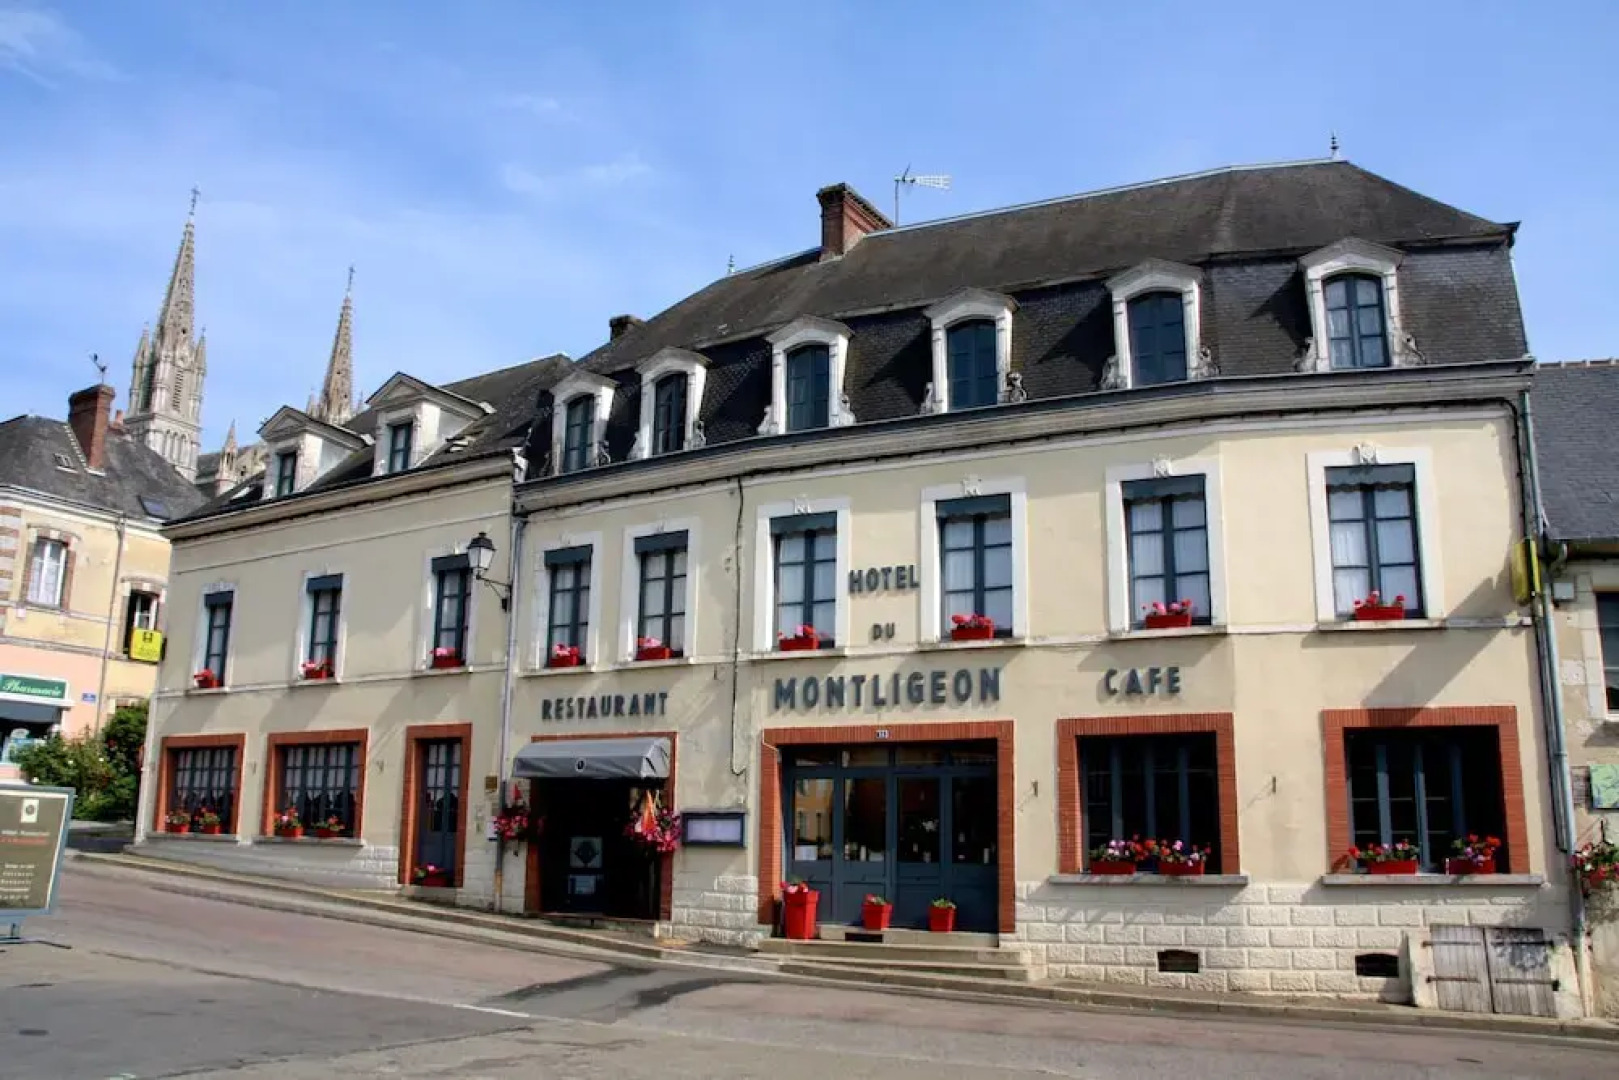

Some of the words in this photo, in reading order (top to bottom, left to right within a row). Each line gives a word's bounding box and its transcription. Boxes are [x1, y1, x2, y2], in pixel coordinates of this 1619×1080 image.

[849, 564, 920, 594] HOTEL
[872, 622, 896, 640] DU
[2, 680, 62, 697] Pharmacie
[774, 666, 1001, 710] MONTLIGEON
[1103, 666, 1181, 696] CAFE
[541, 692, 668, 720] RESTAURANT
